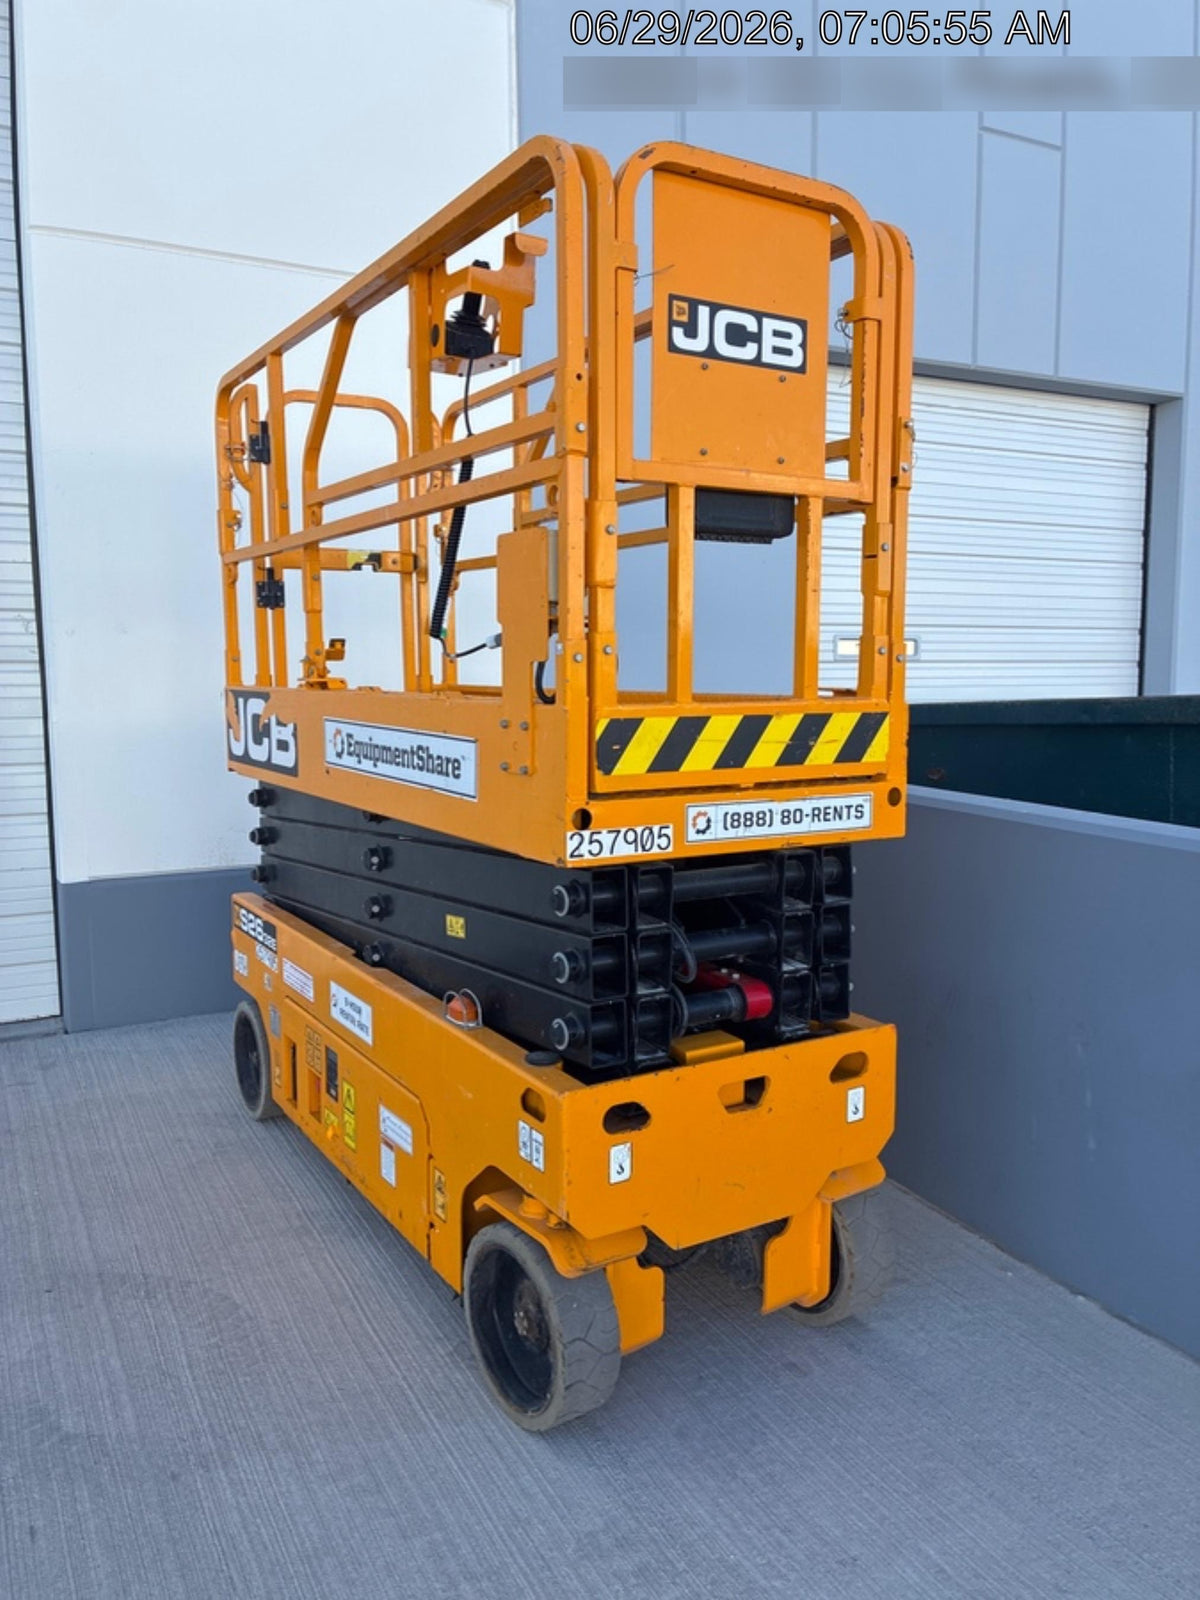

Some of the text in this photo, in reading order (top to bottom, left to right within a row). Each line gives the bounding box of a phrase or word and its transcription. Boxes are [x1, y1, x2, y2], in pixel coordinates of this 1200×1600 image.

[671, 304, 805, 368] JCB
[228, 697, 297, 768] JCB
[345, 732, 462, 780] EquipmentShare
[722, 803, 865, 831] (888) 80-RENTS
[567, 825, 672, 859] 257905
